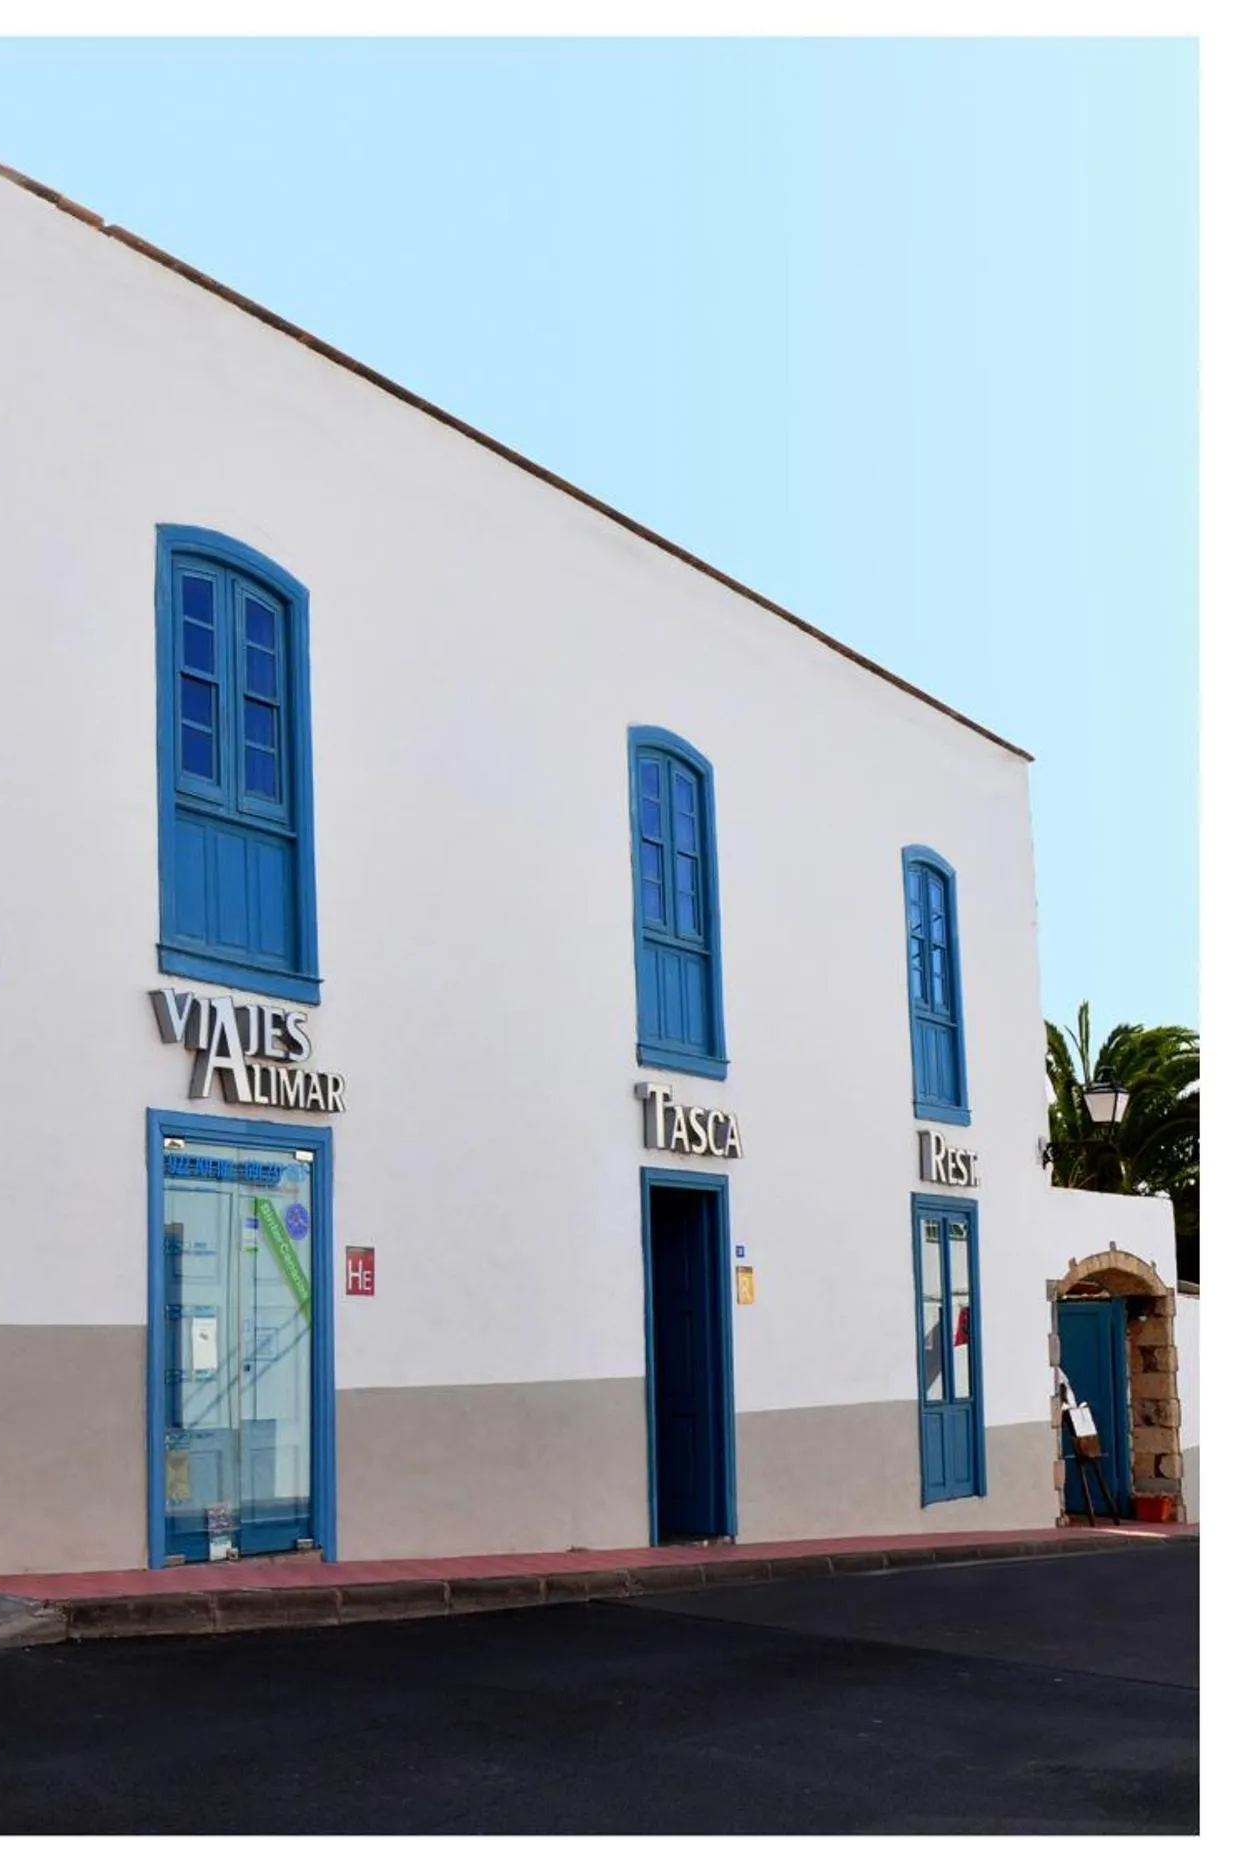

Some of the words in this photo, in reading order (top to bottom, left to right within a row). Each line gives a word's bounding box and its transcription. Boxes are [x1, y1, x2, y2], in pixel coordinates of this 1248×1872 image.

[152, 988, 311, 1080] VIAJES
[198, 996, 347, 1113] ALIMAR
[638, 1082, 742, 1158] TASCA
[348, 1259, 372, 1290] HE
